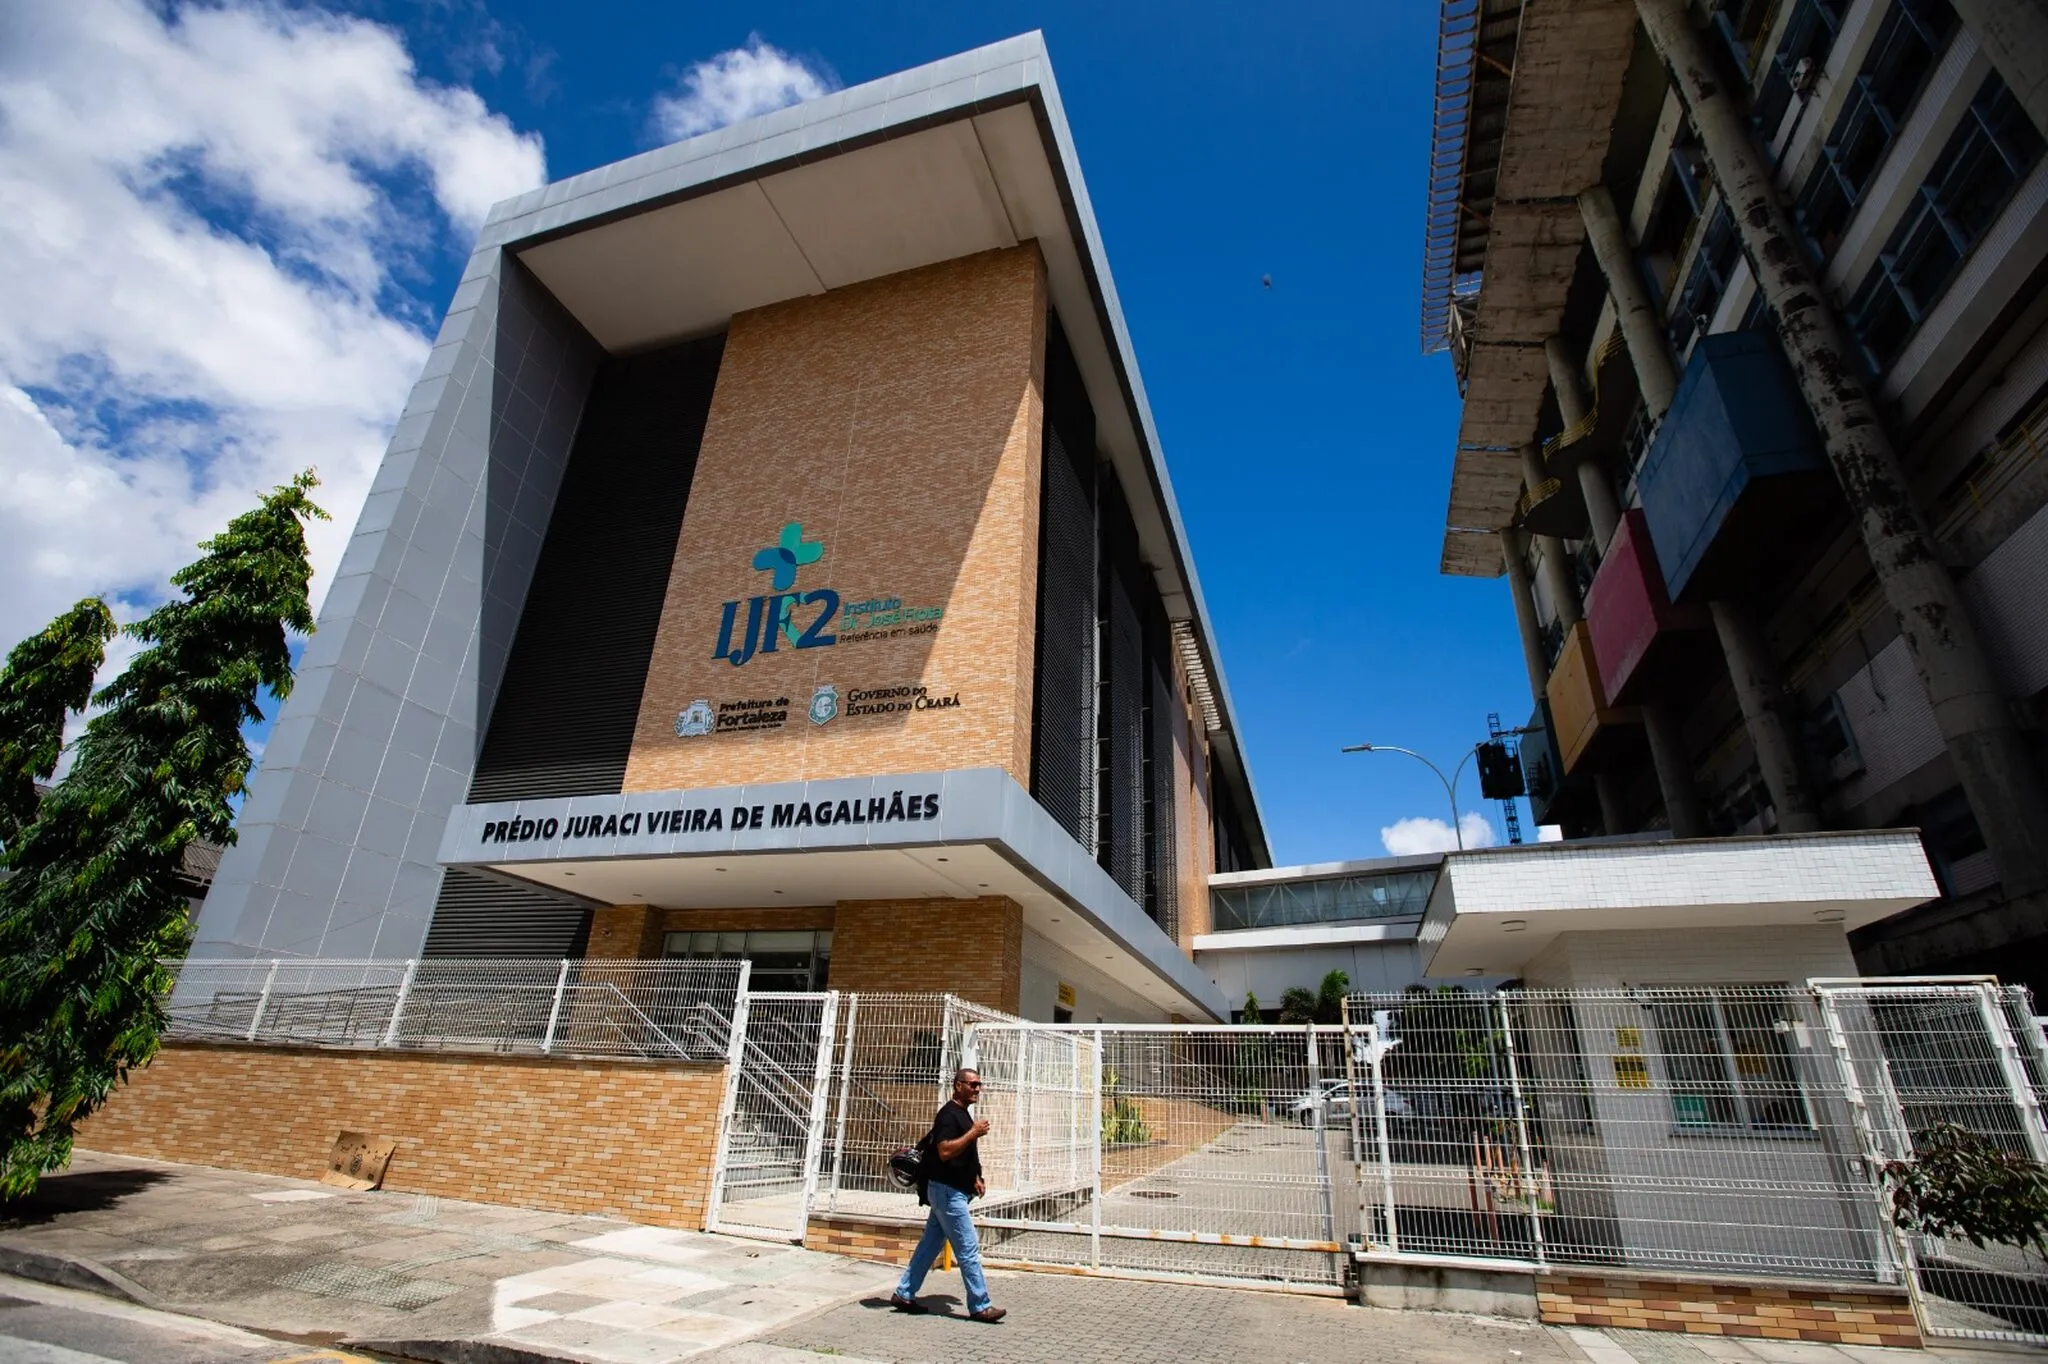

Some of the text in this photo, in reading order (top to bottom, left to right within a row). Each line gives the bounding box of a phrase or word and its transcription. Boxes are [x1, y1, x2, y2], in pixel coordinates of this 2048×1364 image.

[844, 598, 902, 616] Instituto
[864, 608, 900, 629] José
[840, 622, 938, 643] Referência em saúde
[847, 686, 928, 702] GOVERNO DO
[719, 696, 789, 712] Prefeitura de
[846, 692, 960, 716] ESTADO DO CEARÁ
[717, 709, 788, 727] Fortaleza
[481, 790, 939, 843] PRÉDIO JURACI VIEIRA DE MAGALHÃES
